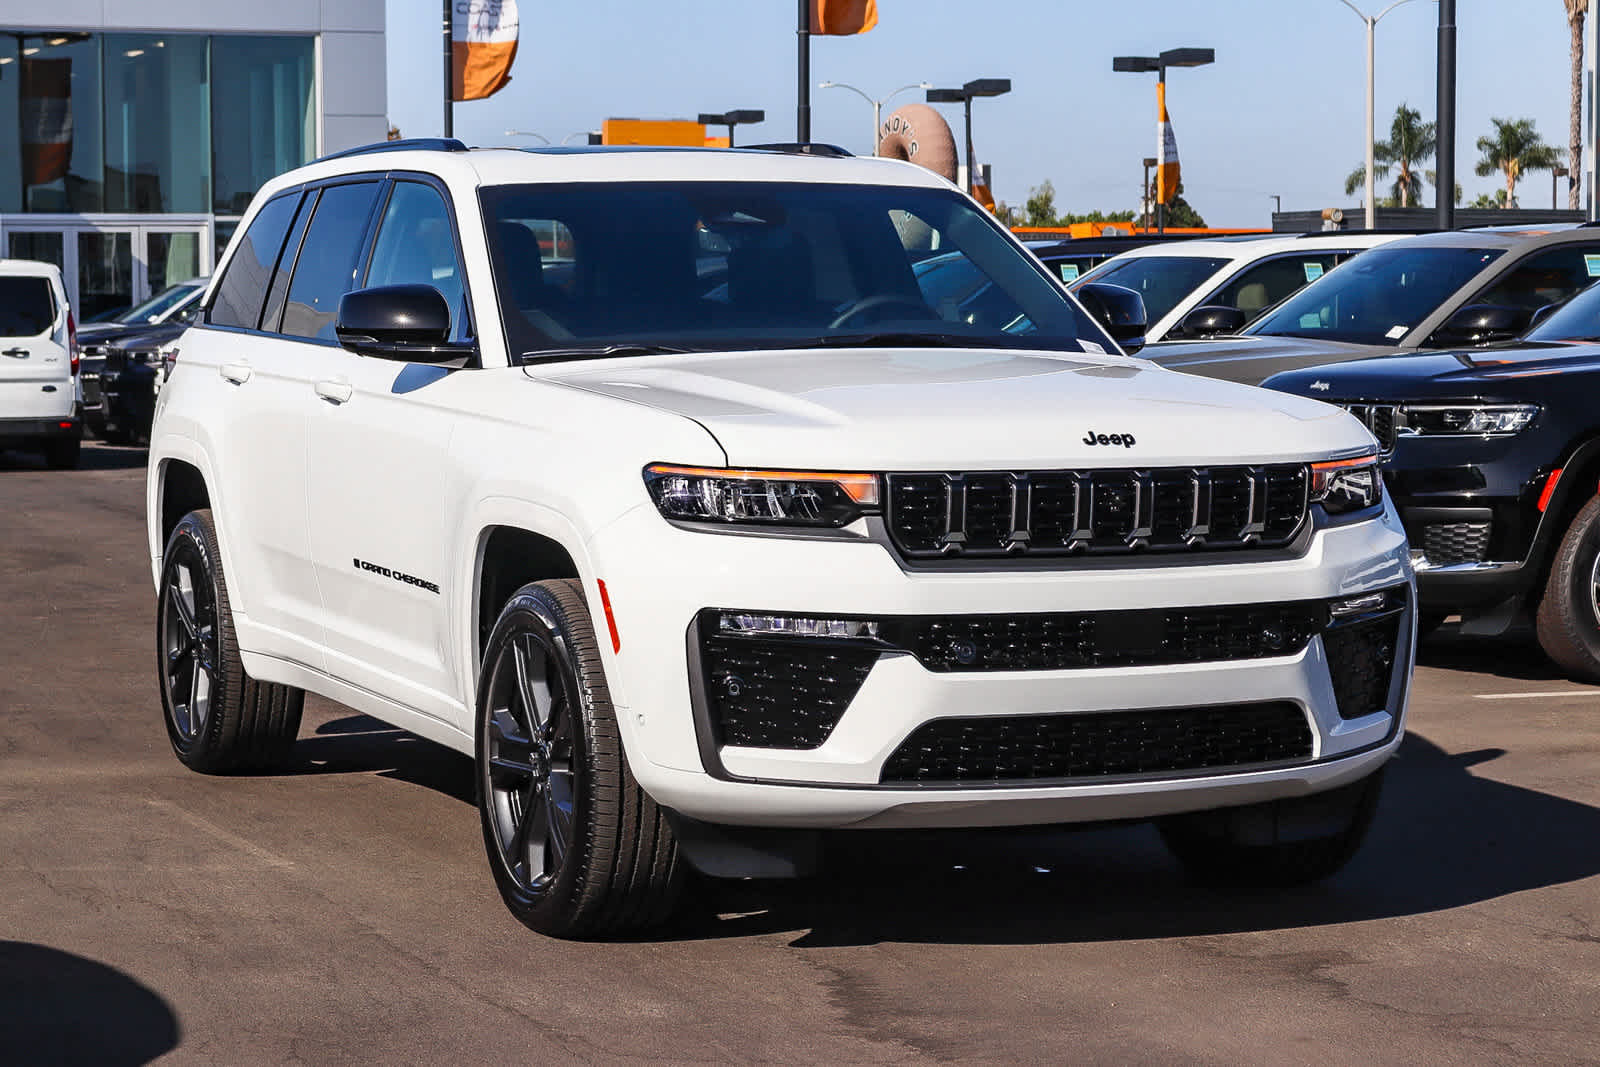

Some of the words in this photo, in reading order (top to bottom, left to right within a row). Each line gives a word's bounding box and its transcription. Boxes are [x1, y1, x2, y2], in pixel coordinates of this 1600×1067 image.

[1082, 430, 1136, 449] Jeep
[361, 561, 391, 578] GRAND
[392, 571, 441, 595] CHEROKEE
